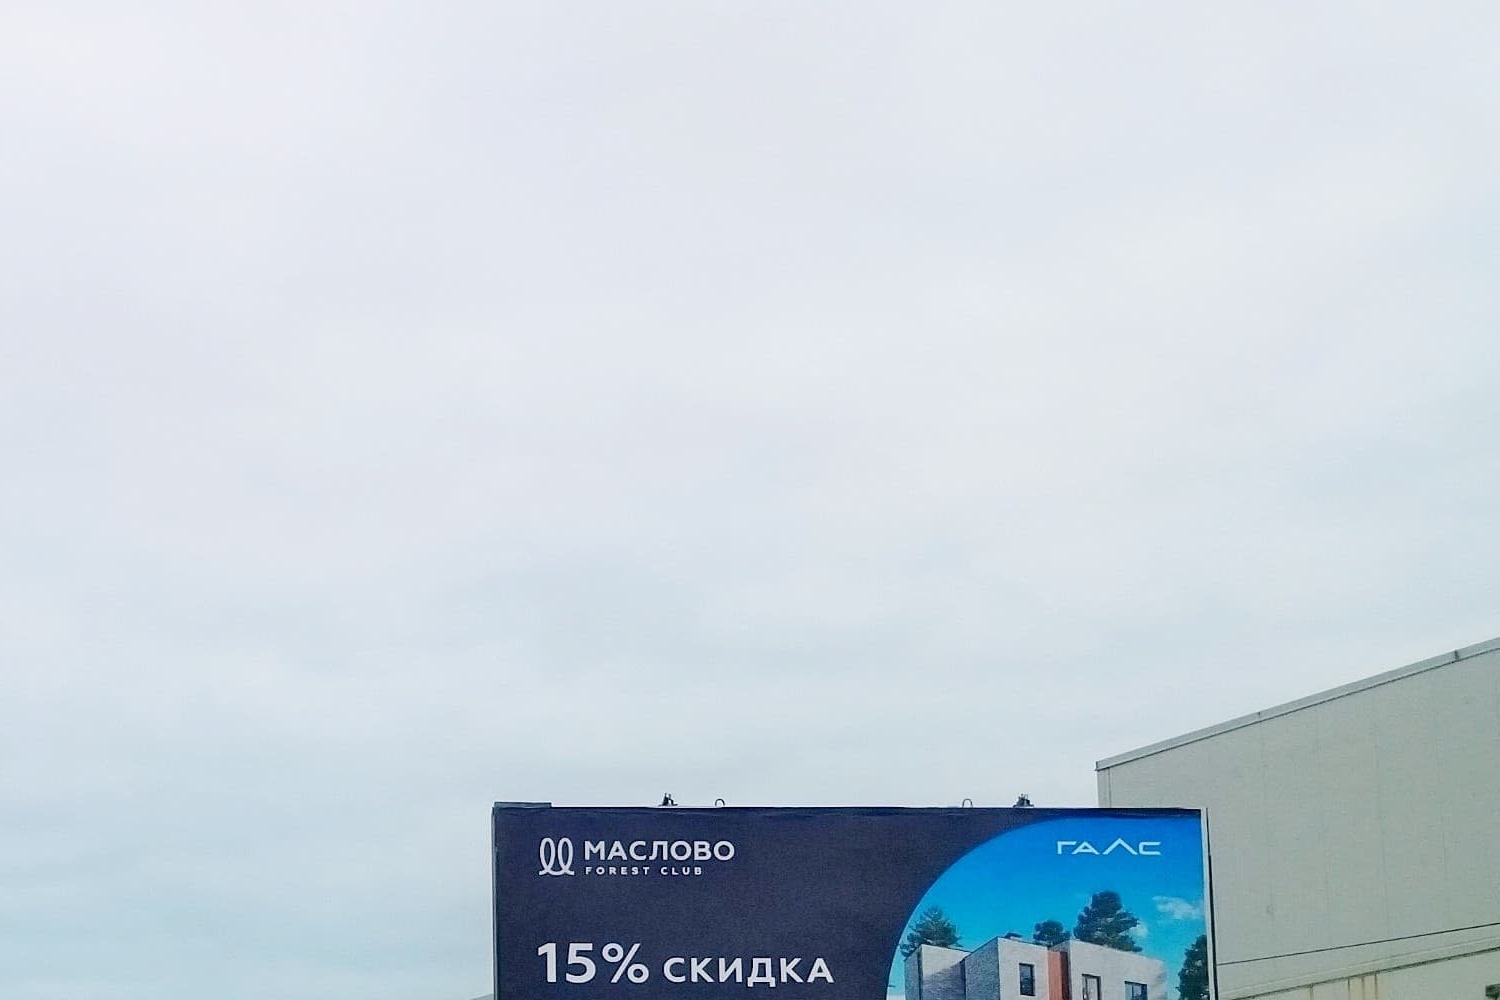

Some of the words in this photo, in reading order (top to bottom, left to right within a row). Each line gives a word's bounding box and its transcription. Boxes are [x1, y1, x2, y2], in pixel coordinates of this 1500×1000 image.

[584, 840, 735, 861] МАСЛОВО
[1057, 838, 1161, 855] ГАЛС
[585, 866, 650, 876] FOREST
[660, 866, 703, 876] CLUB
[537, 942, 650, 984] 15%
[663, 957, 835, 988] СКИДКА
